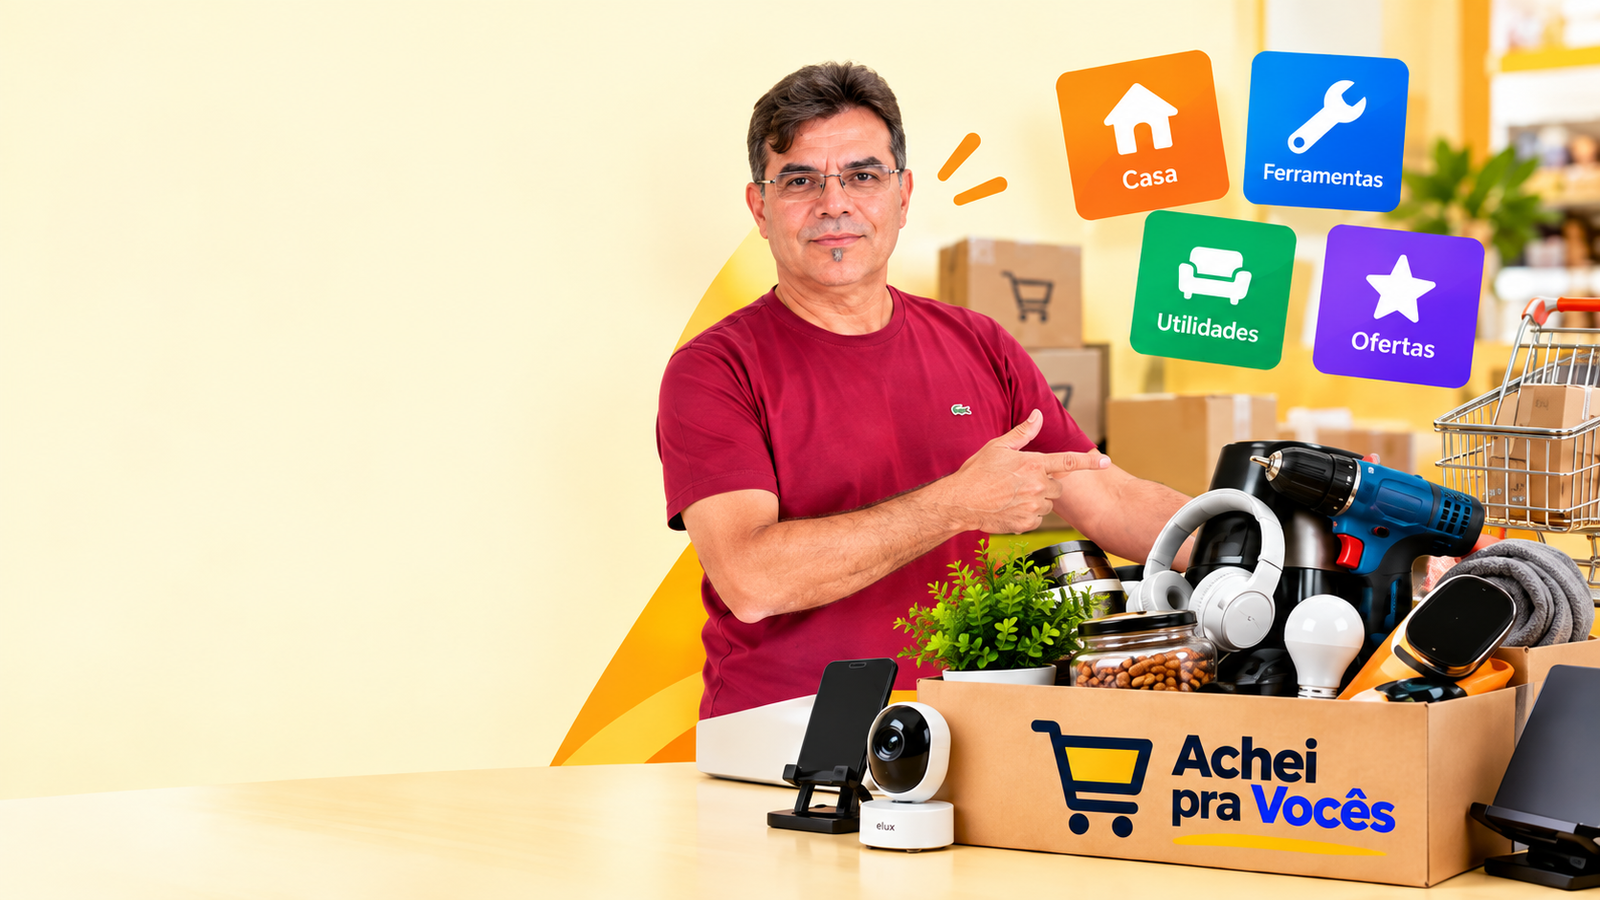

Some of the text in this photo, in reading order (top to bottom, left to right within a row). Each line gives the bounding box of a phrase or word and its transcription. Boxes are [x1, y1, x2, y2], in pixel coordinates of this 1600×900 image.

[1172, 735, 1317, 783] Achei
[876, 821, 896, 832] elux
[1172, 784, 1395, 833] pra Vocês
